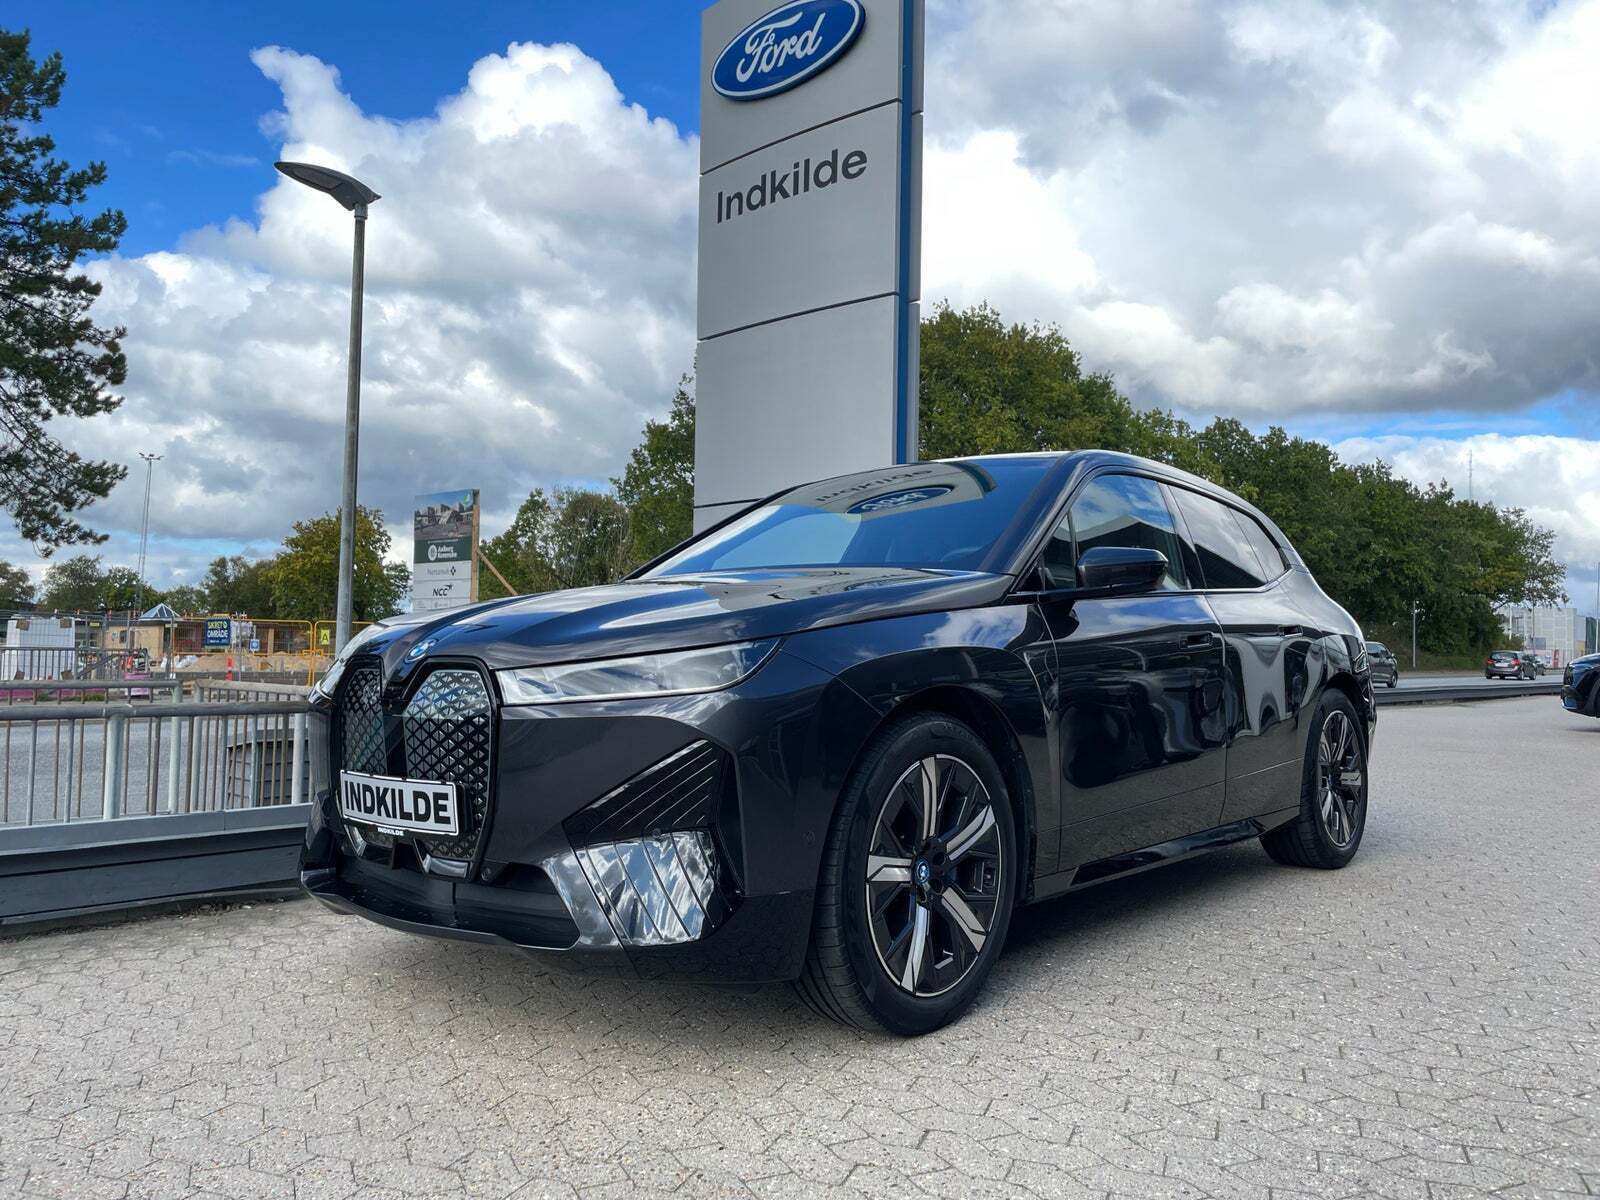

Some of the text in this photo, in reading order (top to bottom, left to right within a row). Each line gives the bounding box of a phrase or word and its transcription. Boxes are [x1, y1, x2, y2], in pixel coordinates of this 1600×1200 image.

[736, 12, 826, 83] Ford
[717, 149, 868, 224] Indkilde
[433, 588, 448, 596] NCC
[344, 780, 452, 825] INDKILDE
